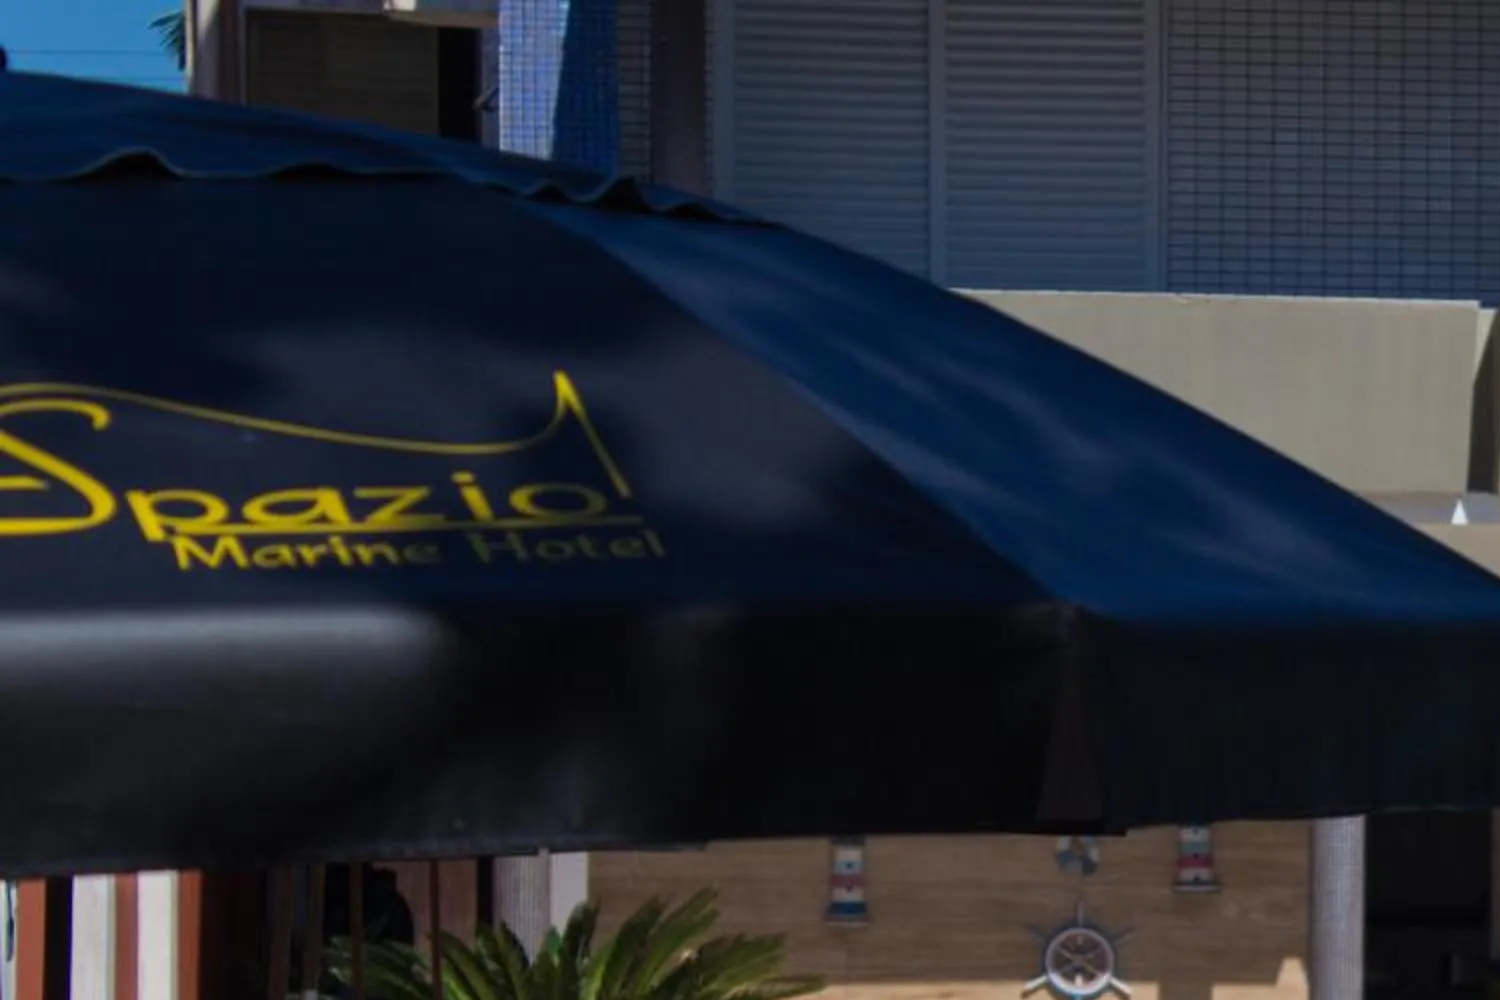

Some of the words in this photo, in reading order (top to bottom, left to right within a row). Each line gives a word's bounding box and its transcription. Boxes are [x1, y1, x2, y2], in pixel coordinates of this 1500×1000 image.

[0, 398, 608, 542] Spazio
[172, 533, 441, 571] Marine
[466, 528, 667, 563] Hotel
